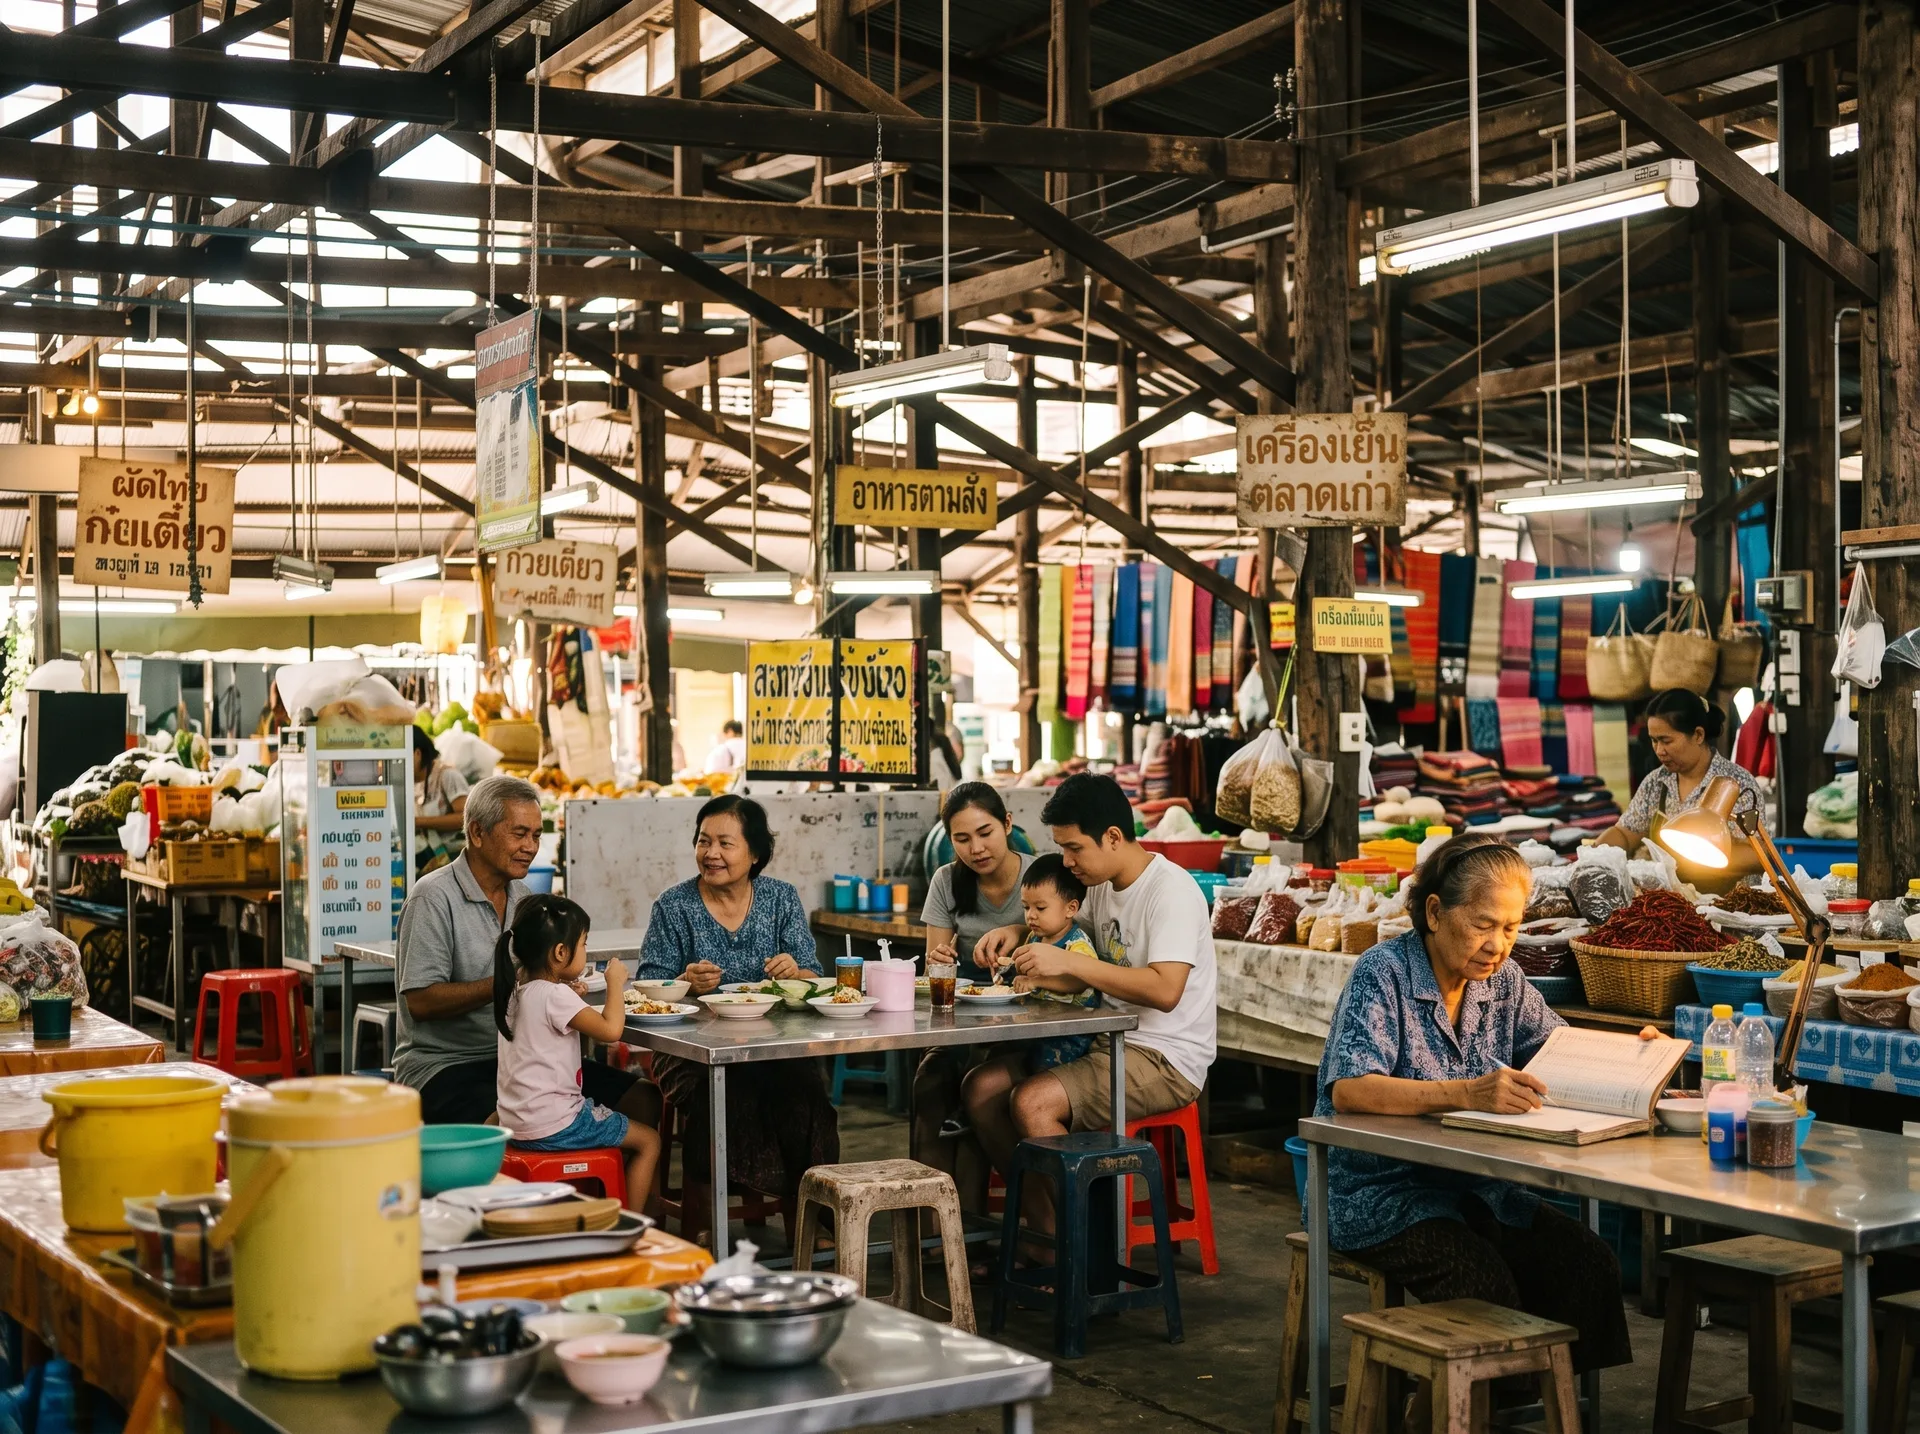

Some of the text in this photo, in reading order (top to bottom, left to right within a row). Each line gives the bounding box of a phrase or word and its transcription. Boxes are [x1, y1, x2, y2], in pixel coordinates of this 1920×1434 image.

[1251, 470, 1392, 512] ตลาดเก่า
[366, 831, 382, 843] 60
